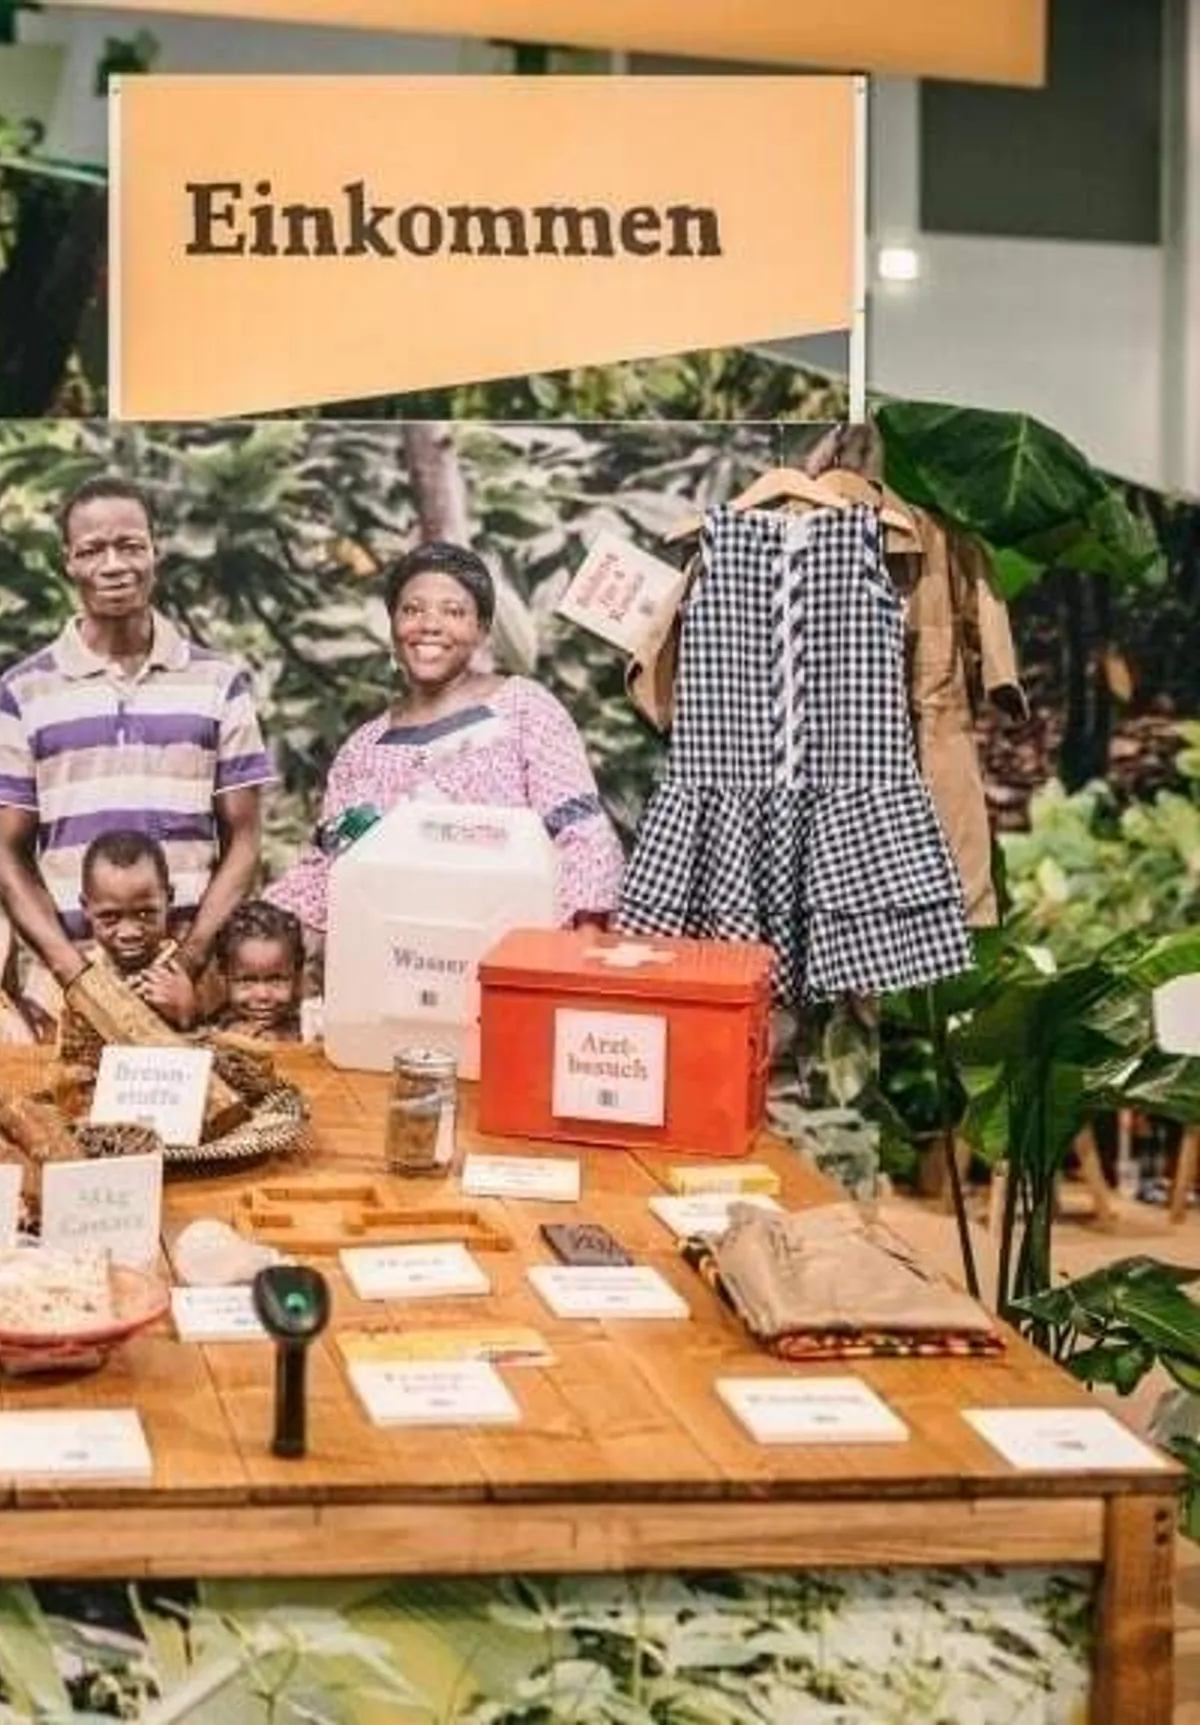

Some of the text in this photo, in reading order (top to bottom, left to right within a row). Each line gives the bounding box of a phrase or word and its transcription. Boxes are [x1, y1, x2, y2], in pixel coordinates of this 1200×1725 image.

[185, 181, 722, 257] Einkommen
[392, 948, 469, 974] Wasser
[581, 1031, 639, 1055] Arzt-
[566, 1053, 650, 1080] besuch
